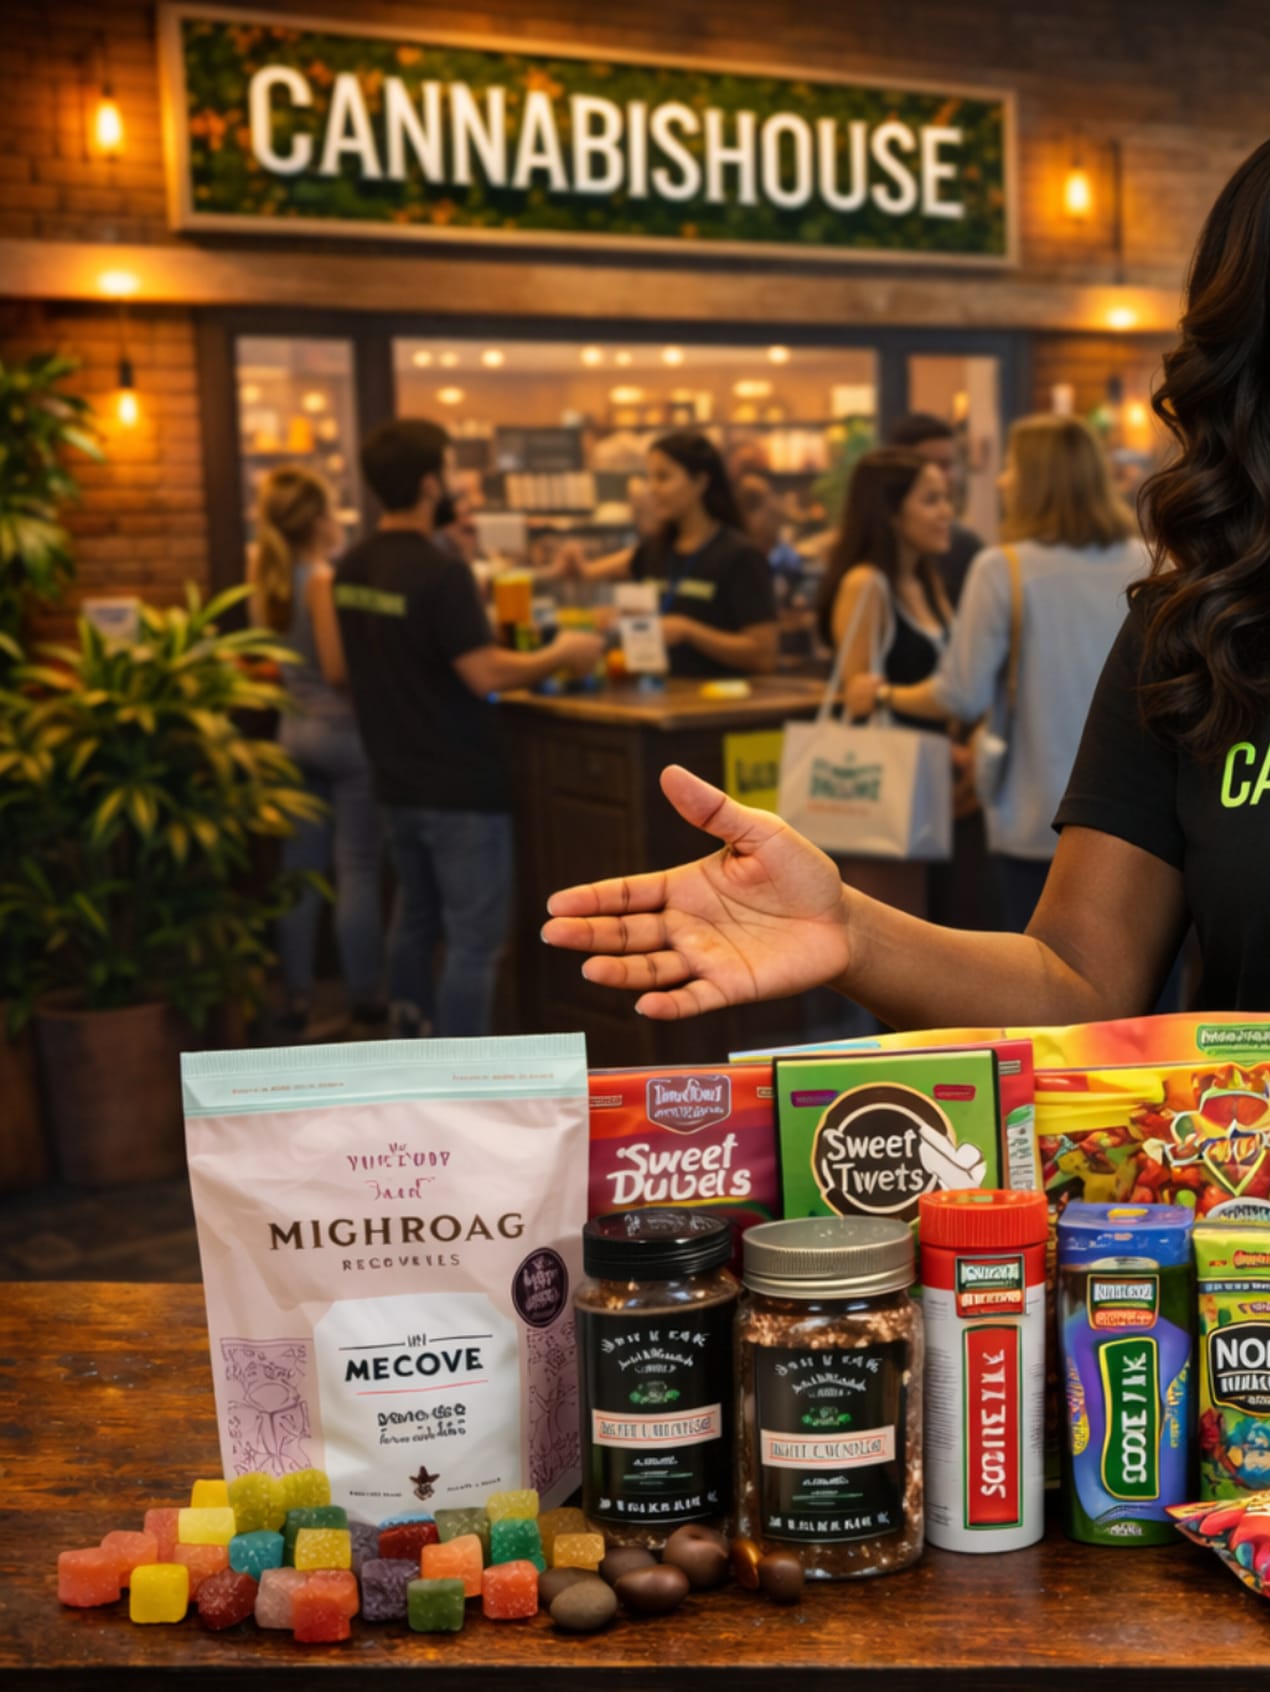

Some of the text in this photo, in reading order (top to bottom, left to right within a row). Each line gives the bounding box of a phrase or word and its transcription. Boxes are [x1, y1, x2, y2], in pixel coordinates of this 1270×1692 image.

[249, 65, 965, 219] CANNABISHOUSE
[616, 1133, 739, 1176] Sweet
[823, 1128, 917, 1161] Sweet
[267, 1212, 526, 1251] MIGHROAG
[345, 1347, 484, 1382] MECOVE
